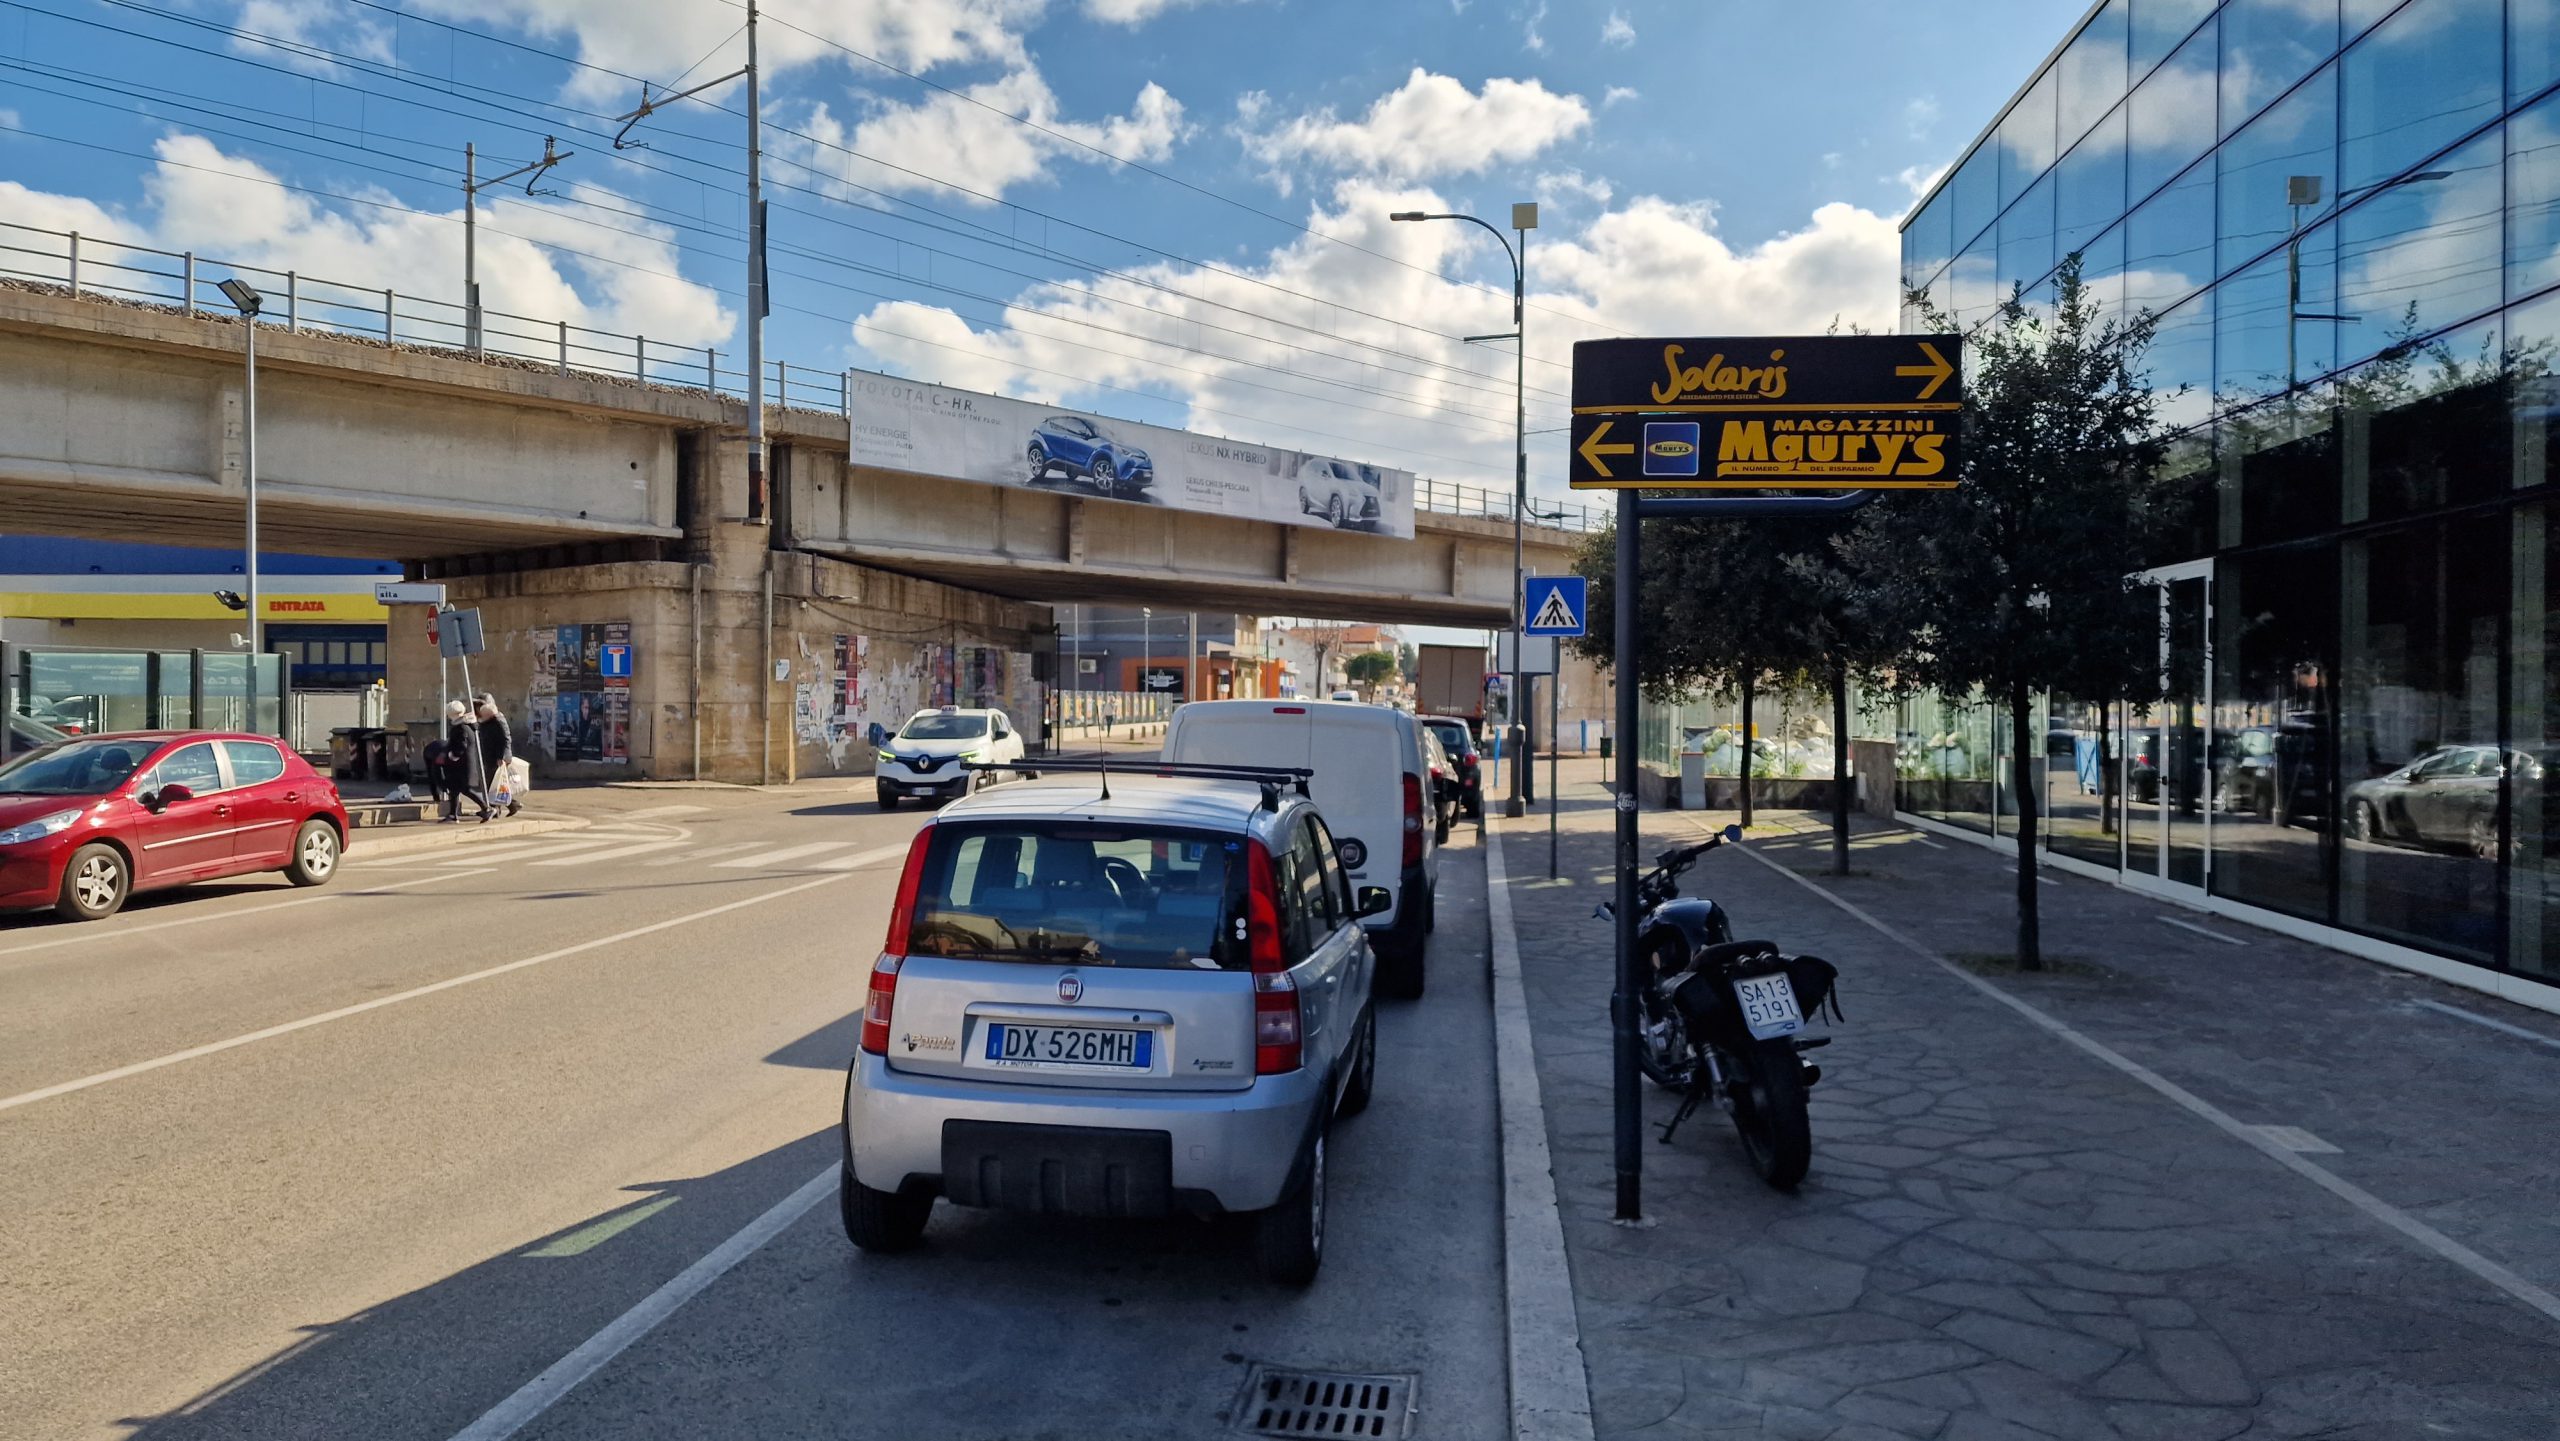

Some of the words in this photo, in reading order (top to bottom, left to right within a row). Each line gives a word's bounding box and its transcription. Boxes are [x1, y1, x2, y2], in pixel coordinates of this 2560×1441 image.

[1651, 344, 1788, 404] Solaris
[856, 379, 924, 403] TOYOTA
[1773, 420, 1934, 432] MAGAZZINI
[1186, 441, 1214, 456] LEXUS
[1217, 446, 1230, 459] NX
[1233, 449, 1267, 465] HYBRID
[1718, 420, 1945, 476] Maury's
[269, 601, 326, 611] ENTRATA
[1061, 983, 1078, 996] FIAT
[1749, 999, 1796, 1022] 5191
[1005, 1028, 1038, 1059] DX
[1049, 1030, 1134, 1063] 526MH
